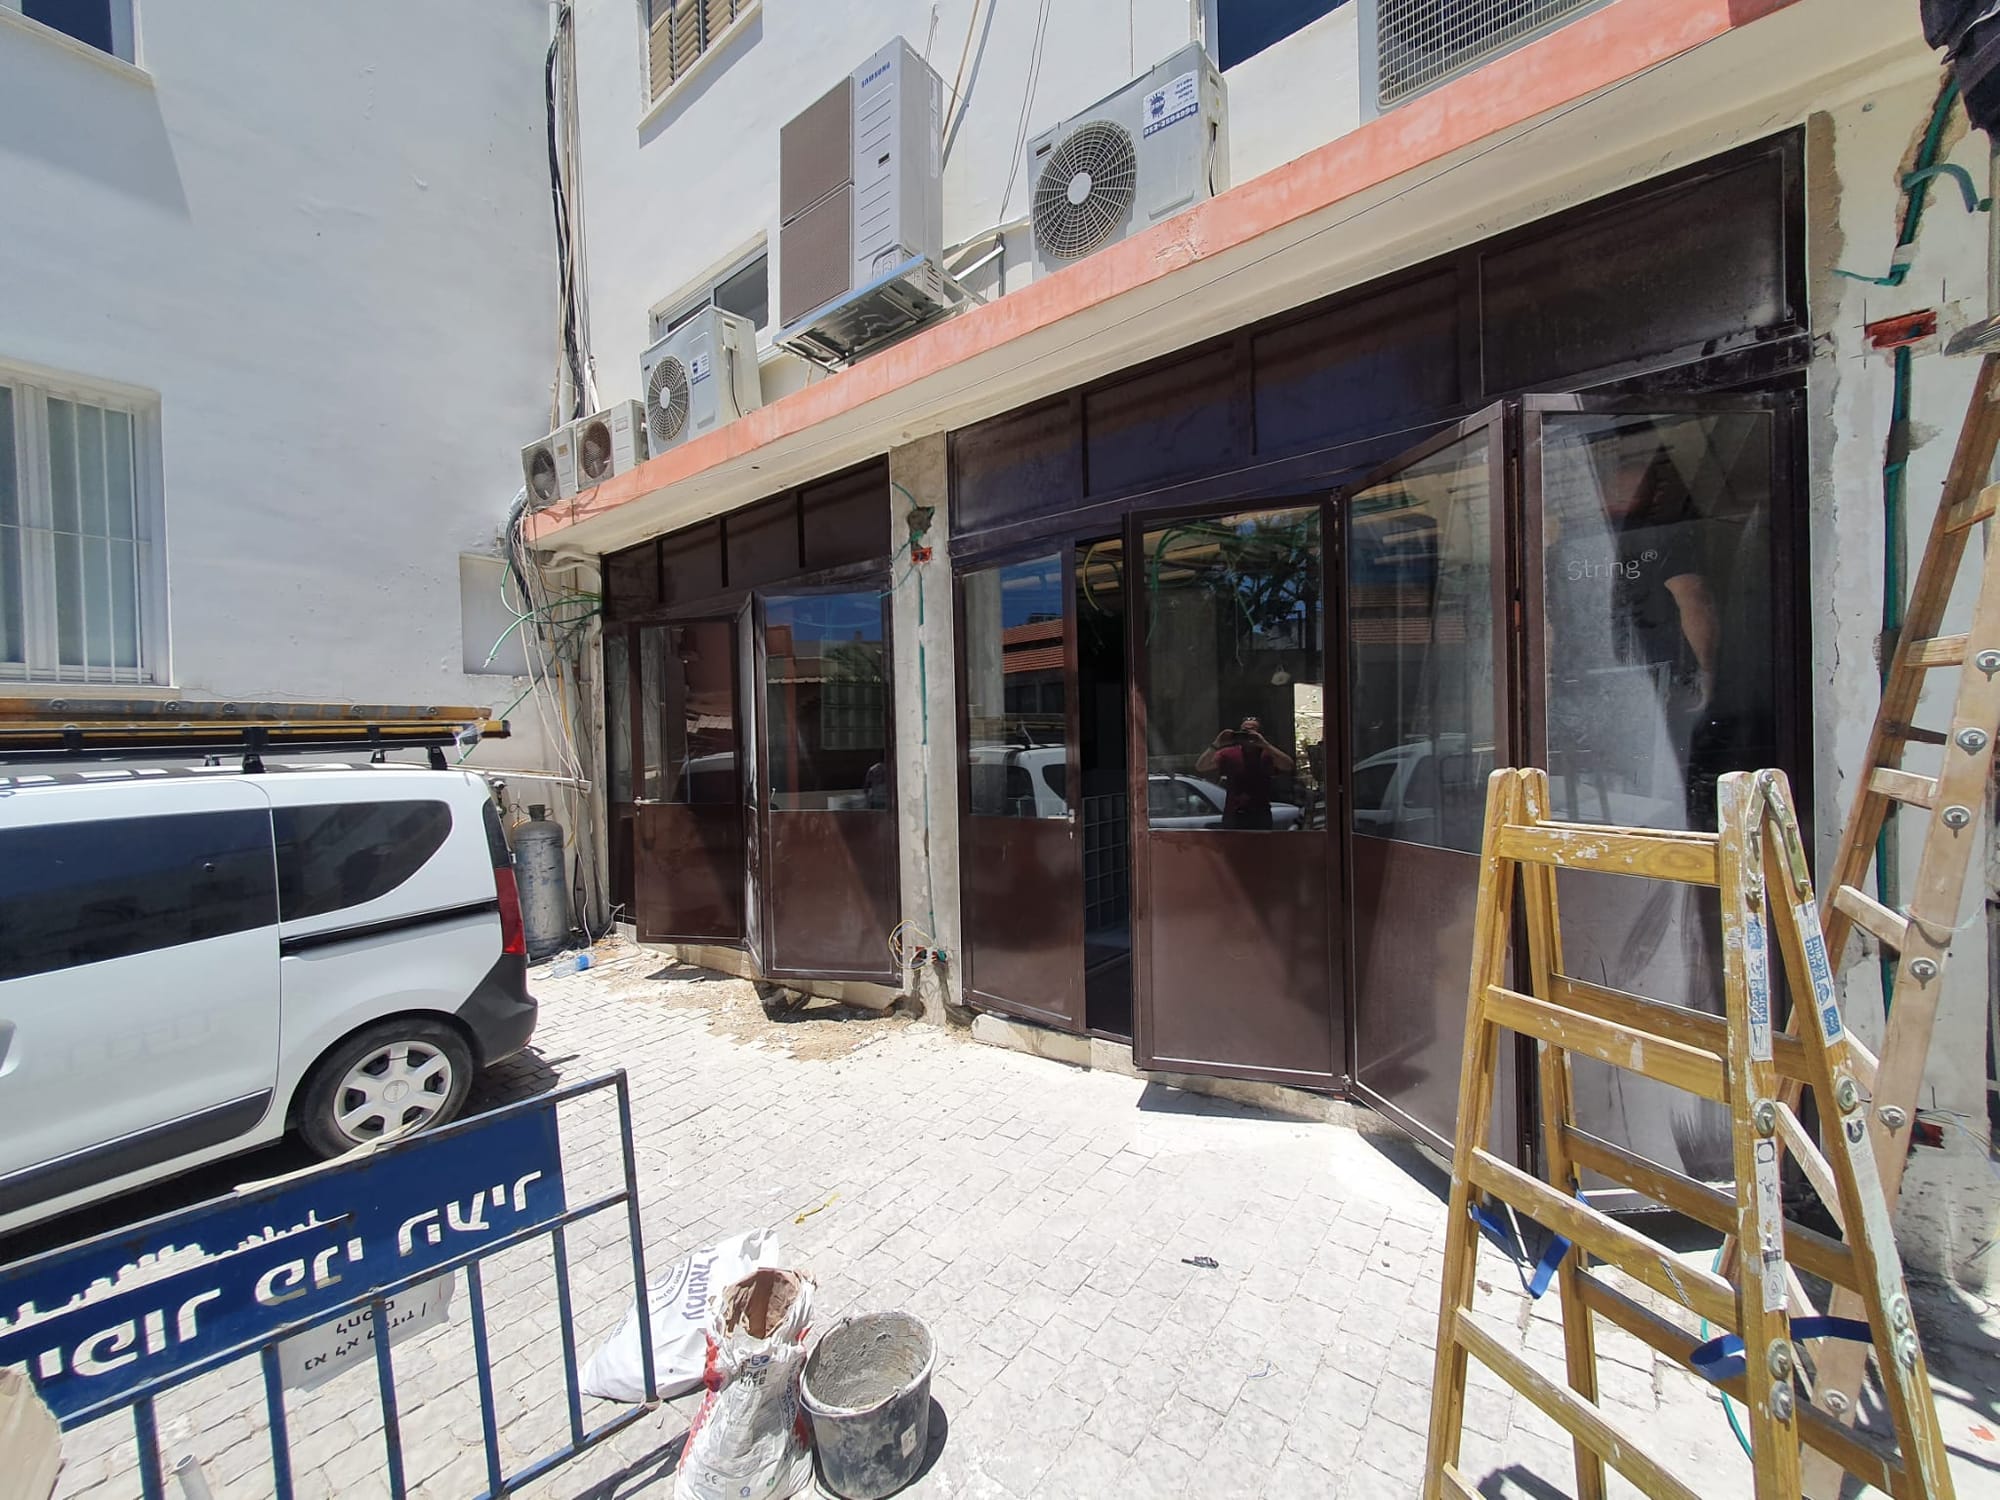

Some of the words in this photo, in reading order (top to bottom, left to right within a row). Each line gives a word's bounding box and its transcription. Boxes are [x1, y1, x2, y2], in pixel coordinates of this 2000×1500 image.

[304, 1352, 327, 1370] נא
[335, 1337, 359, 1356] לא
[366, 1309, 415, 1340] לזיז
[336, 1300, 395, 1335] לחסם
